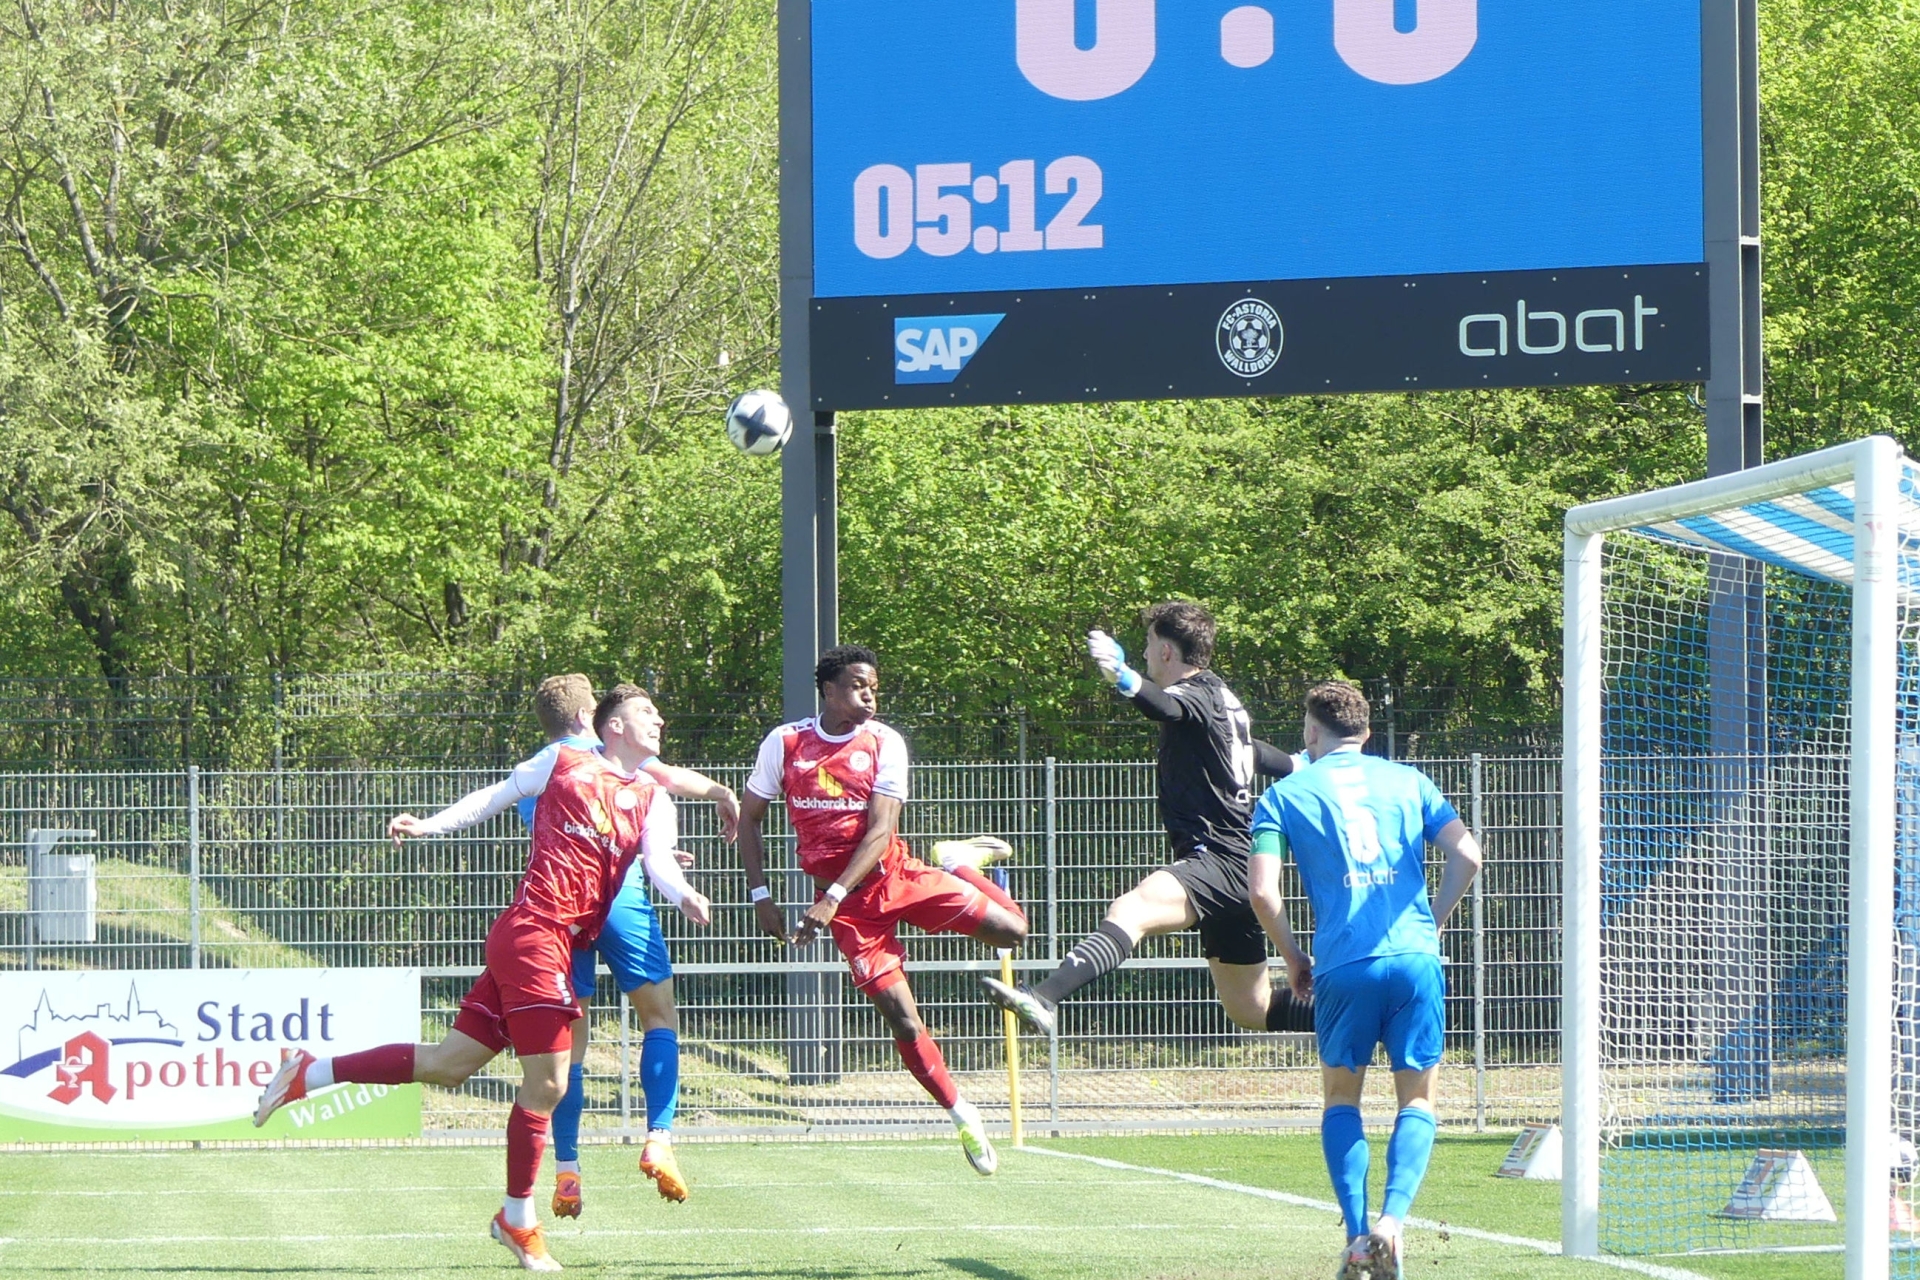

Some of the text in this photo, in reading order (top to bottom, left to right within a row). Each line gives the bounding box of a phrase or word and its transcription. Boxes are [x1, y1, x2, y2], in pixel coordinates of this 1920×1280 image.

[852, 155, 1104, 260] 05:12
[1458, 294, 1659, 357] abat
[895, 326, 980, 374] SAP
[1223, 348, 1276, 373] WALLDORF
[196, 997, 335, 1043] Stadt
[288, 1083, 400, 1129] Walldo
